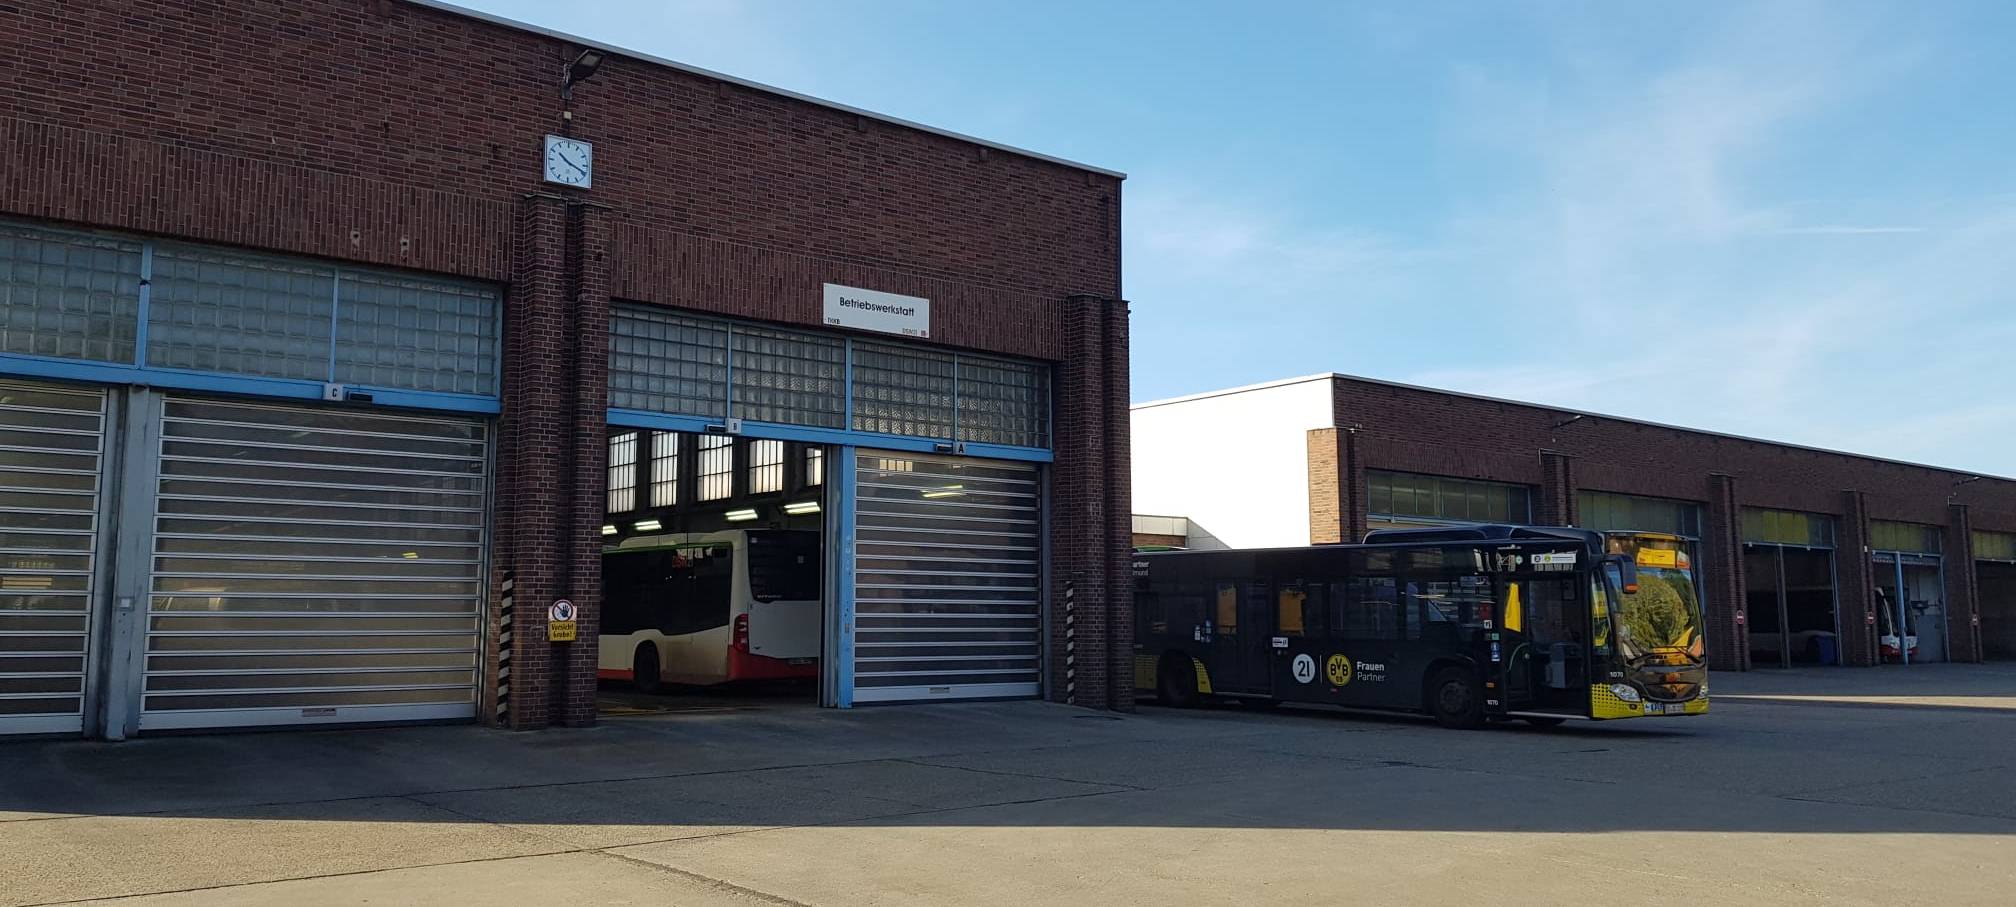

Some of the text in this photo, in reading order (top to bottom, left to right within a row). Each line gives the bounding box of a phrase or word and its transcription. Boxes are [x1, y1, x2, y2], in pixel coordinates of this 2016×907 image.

[839, 296, 915, 316] Betriebswerkstatt
[332, 387, 338, 398] C
[958, 443, 964, 453] A
[1297, 660, 1310, 677] 21
[1330, 657, 1349, 677] BVB
[1356, 661, 1385, 672] Frauen
[1357, 671, 1385, 682] Partner
